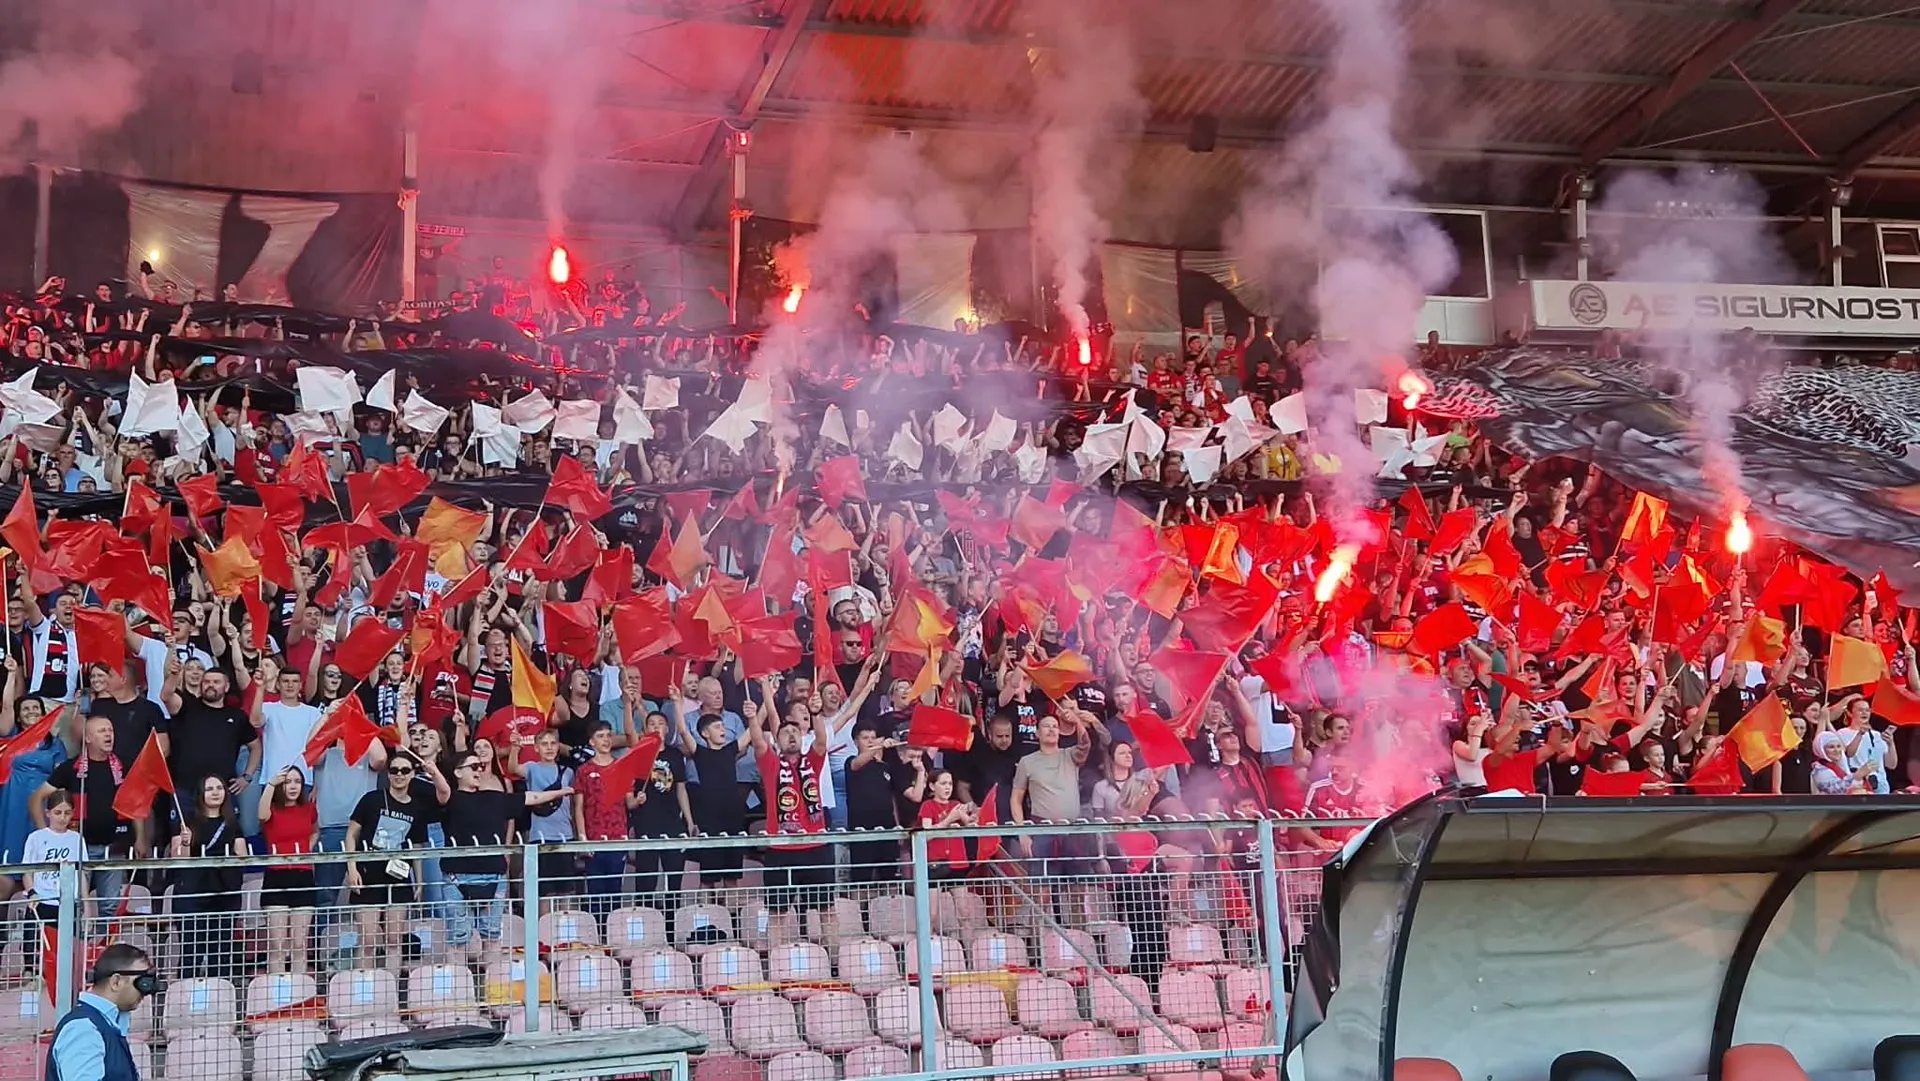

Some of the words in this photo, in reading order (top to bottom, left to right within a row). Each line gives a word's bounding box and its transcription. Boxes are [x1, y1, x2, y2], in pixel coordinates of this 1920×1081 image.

[1622, 293, 1679, 316] AE
[1695, 296, 1920, 320] SIGURNOST
[435, 671, 459, 683] EVO
[45, 847, 70, 860] EVO
